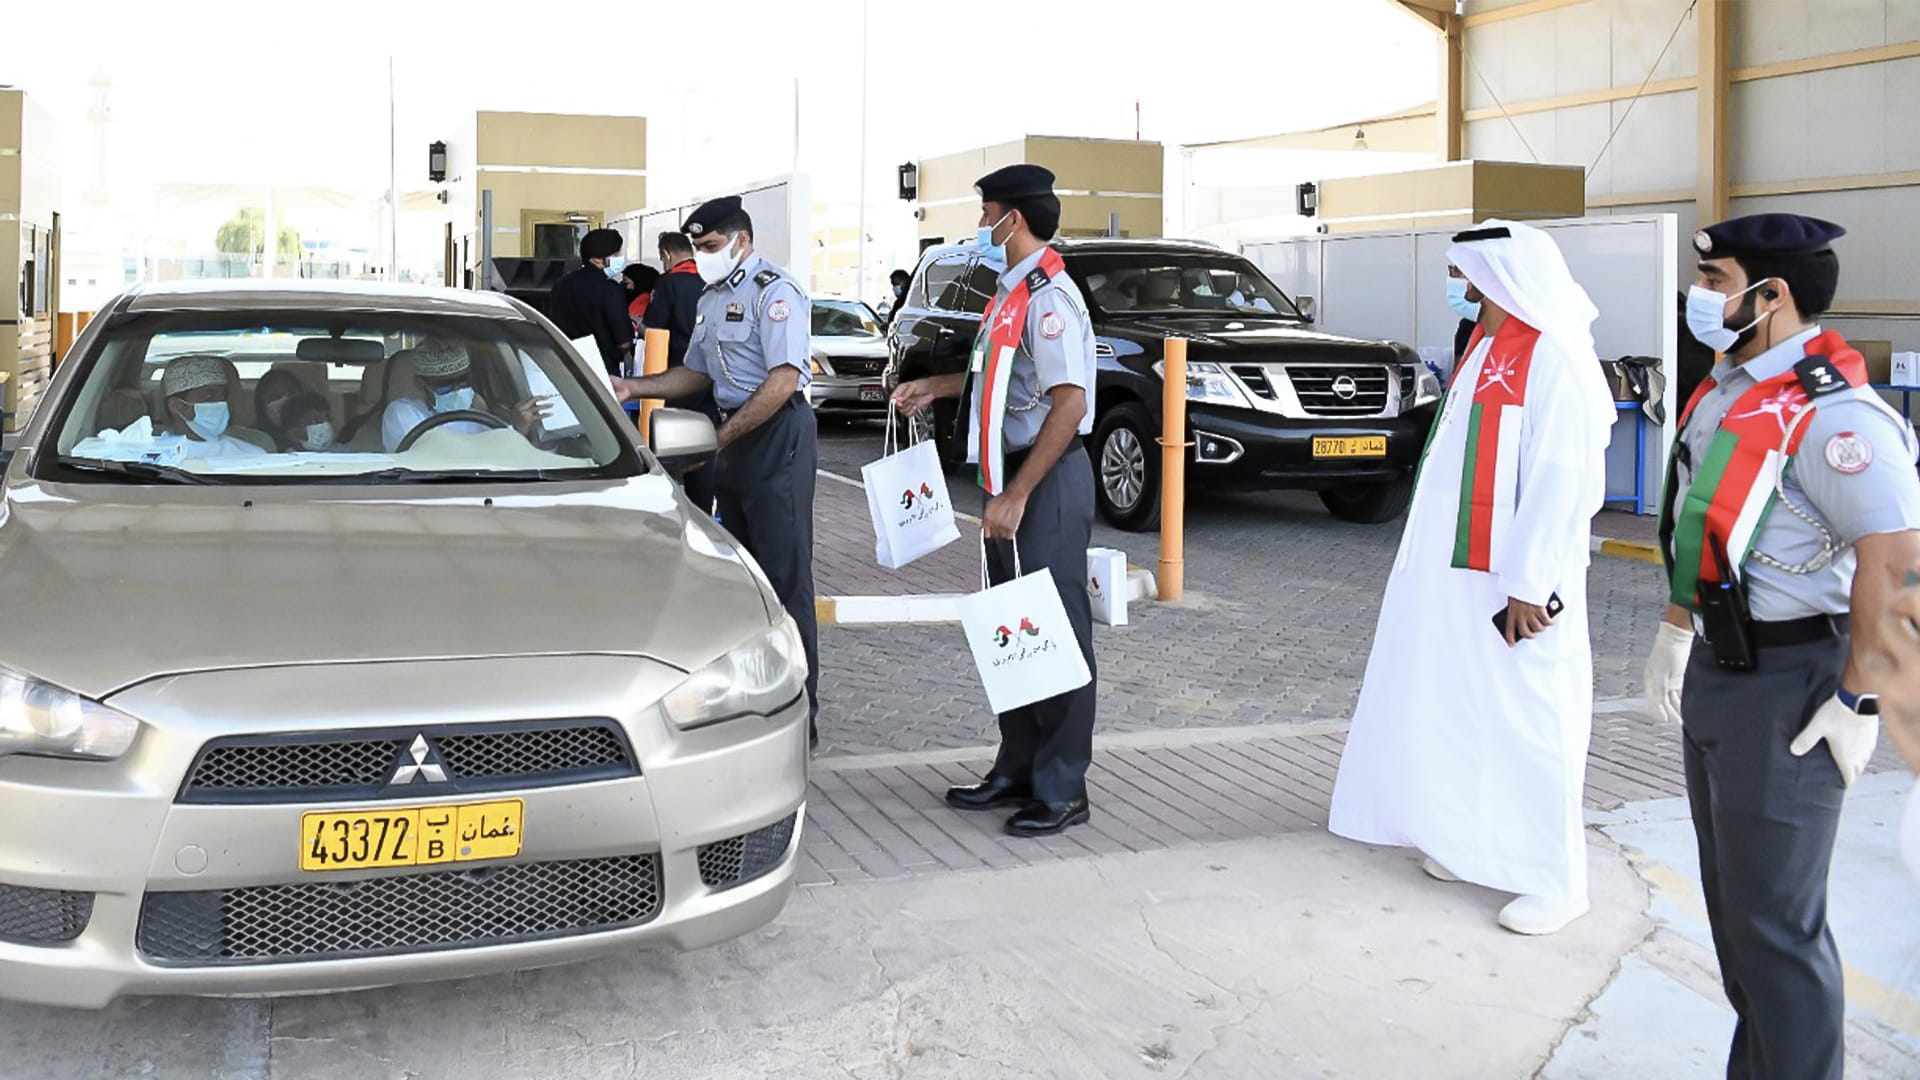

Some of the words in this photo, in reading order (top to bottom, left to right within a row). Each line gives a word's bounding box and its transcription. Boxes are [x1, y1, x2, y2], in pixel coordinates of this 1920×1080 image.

[427, 813, 449, 834] ب
[311, 817, 410, 864] 43372
[428, 840, 444, 859] B
